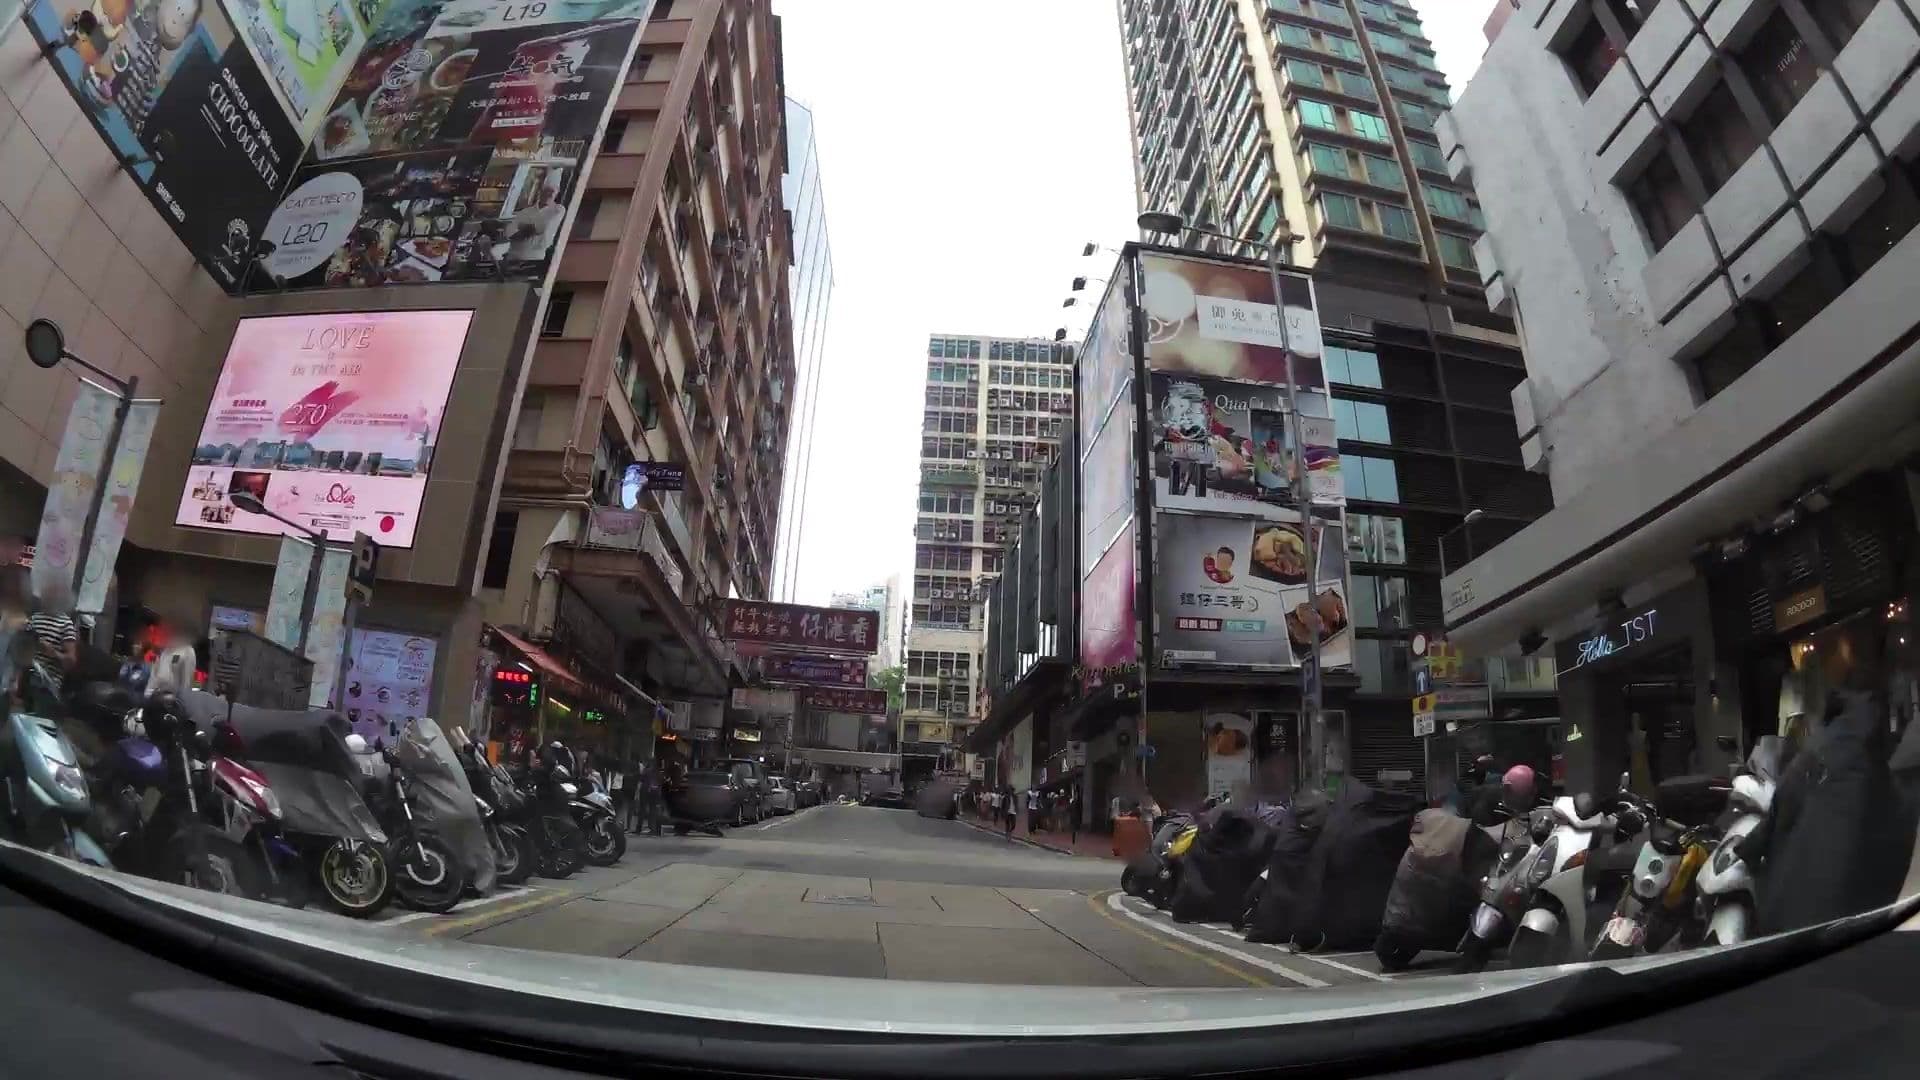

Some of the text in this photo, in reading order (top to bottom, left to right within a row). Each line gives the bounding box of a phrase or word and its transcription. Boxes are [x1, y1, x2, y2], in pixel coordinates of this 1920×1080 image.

[503, 2, 546, 21] L19
[282, 221, 329, 246] L20
[301, 326, 375, 350] LOVE
[1785, 597, 1816, 617] ROCOCO
[1576, 609, 1657, 668] Hello TST
